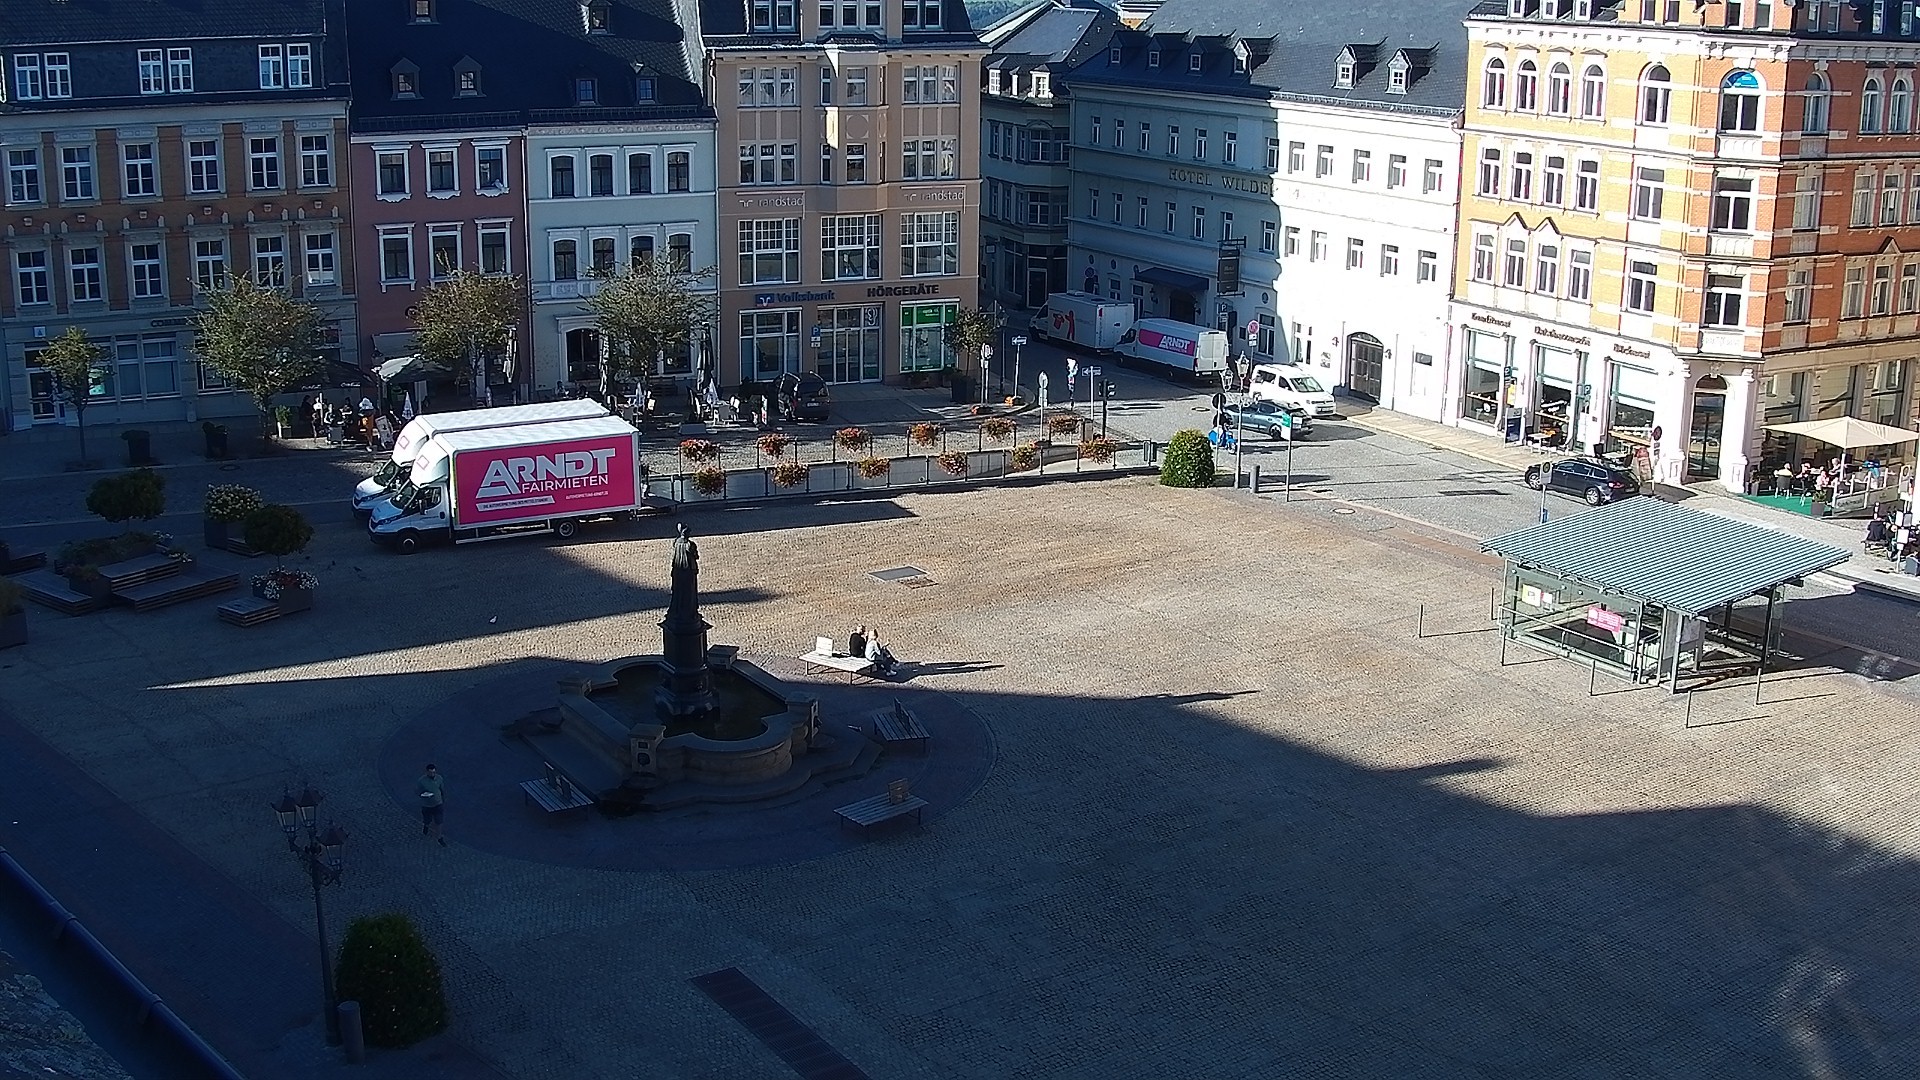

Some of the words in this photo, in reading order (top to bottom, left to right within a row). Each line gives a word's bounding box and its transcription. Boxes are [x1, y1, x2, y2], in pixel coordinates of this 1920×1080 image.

[1169, 168, 1212, 186] HOTEL
[758, 195, 804, 207] randstad
[921, 190, 964, 201] randstad
[777, 290, 835, 302] Volksbank
[867, 284, 939, 297] HÖRGERÄTE
[1159, 335, 1190, 350] ARNDT
[476, 448, 615, 498] ARNDT
[522, 475, 609, 493] FAIRMIETEN
